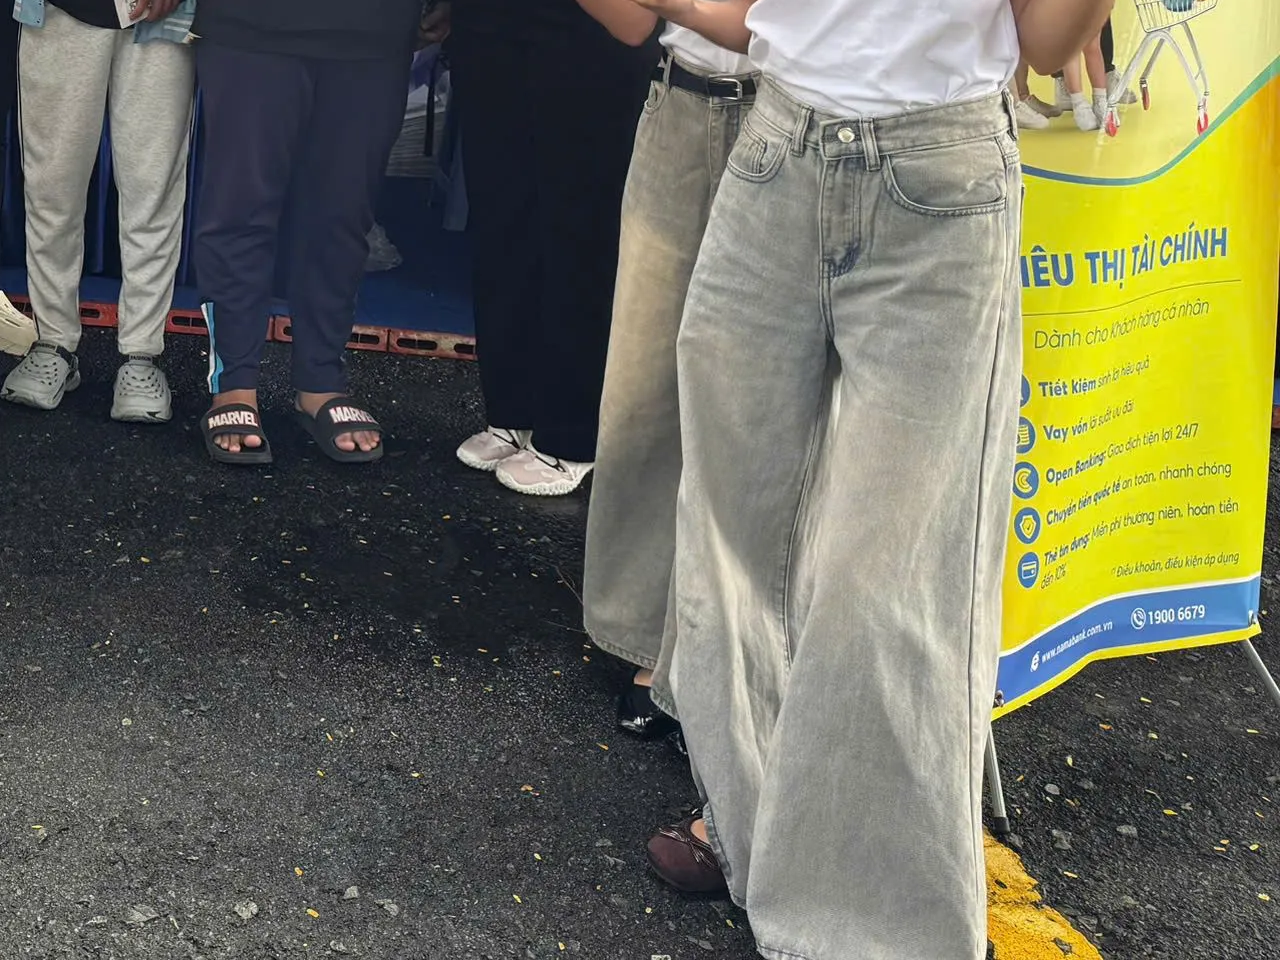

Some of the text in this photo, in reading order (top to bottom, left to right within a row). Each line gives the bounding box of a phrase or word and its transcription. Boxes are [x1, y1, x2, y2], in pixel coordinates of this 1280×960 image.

[1085, 248, 1126, 289] THỊ
[1131, 233, 1156, 277] TÀI
[1159, 221, 1228, 267] CHÍNH
[1034, 328, 1081, 349] Dành
[1085, 326, 1109, 345] cho
[1138, 307, 1160, 332] hàng
[1162, 301, 1176, 322] cá
[1178, 298, 1210, 318] nhân
[1038, 379, 1068, 397] Tiết
[1071, 378, 1096, 395] kiệm
[208, 411, 258, 429] MARVEL
[1043, 424, 1068, 443] Vay
[1071, 417, 1088, 436] vốn
[1046, 466, 1073, 486] Open
[1107, 444, 1123, 458] Giao
[1125, 437, 1141, 451] dịch
[1143, 432, 1159, 447] tiện
[1162, 428, 1173, 442] lợi
[1175, 423, 1198, 439] 24/7
[1046, 500, 1077, 525] Chuyển
[1093, 485, 1111, 505] quốc
[1111, 476, 1120, 494] tế
[1122, 479, 1133, 489] an
[1159, 465, 1193, 480] nhanh
[1197, 462, 1231, 478] chóng
[1188, 503, 1215, 517] hoàn
[1219, 498, 1238, 513] tiền
[1165, 556, 1183, 570] điều
[1185, 555, 1203, 568] kiện
[1204, 553, 1215, 567] áp
[1217, 551, 1239, 565] dụng
[1041, 605, 1205, 663] www.namabank.com.vn 1900 6679
